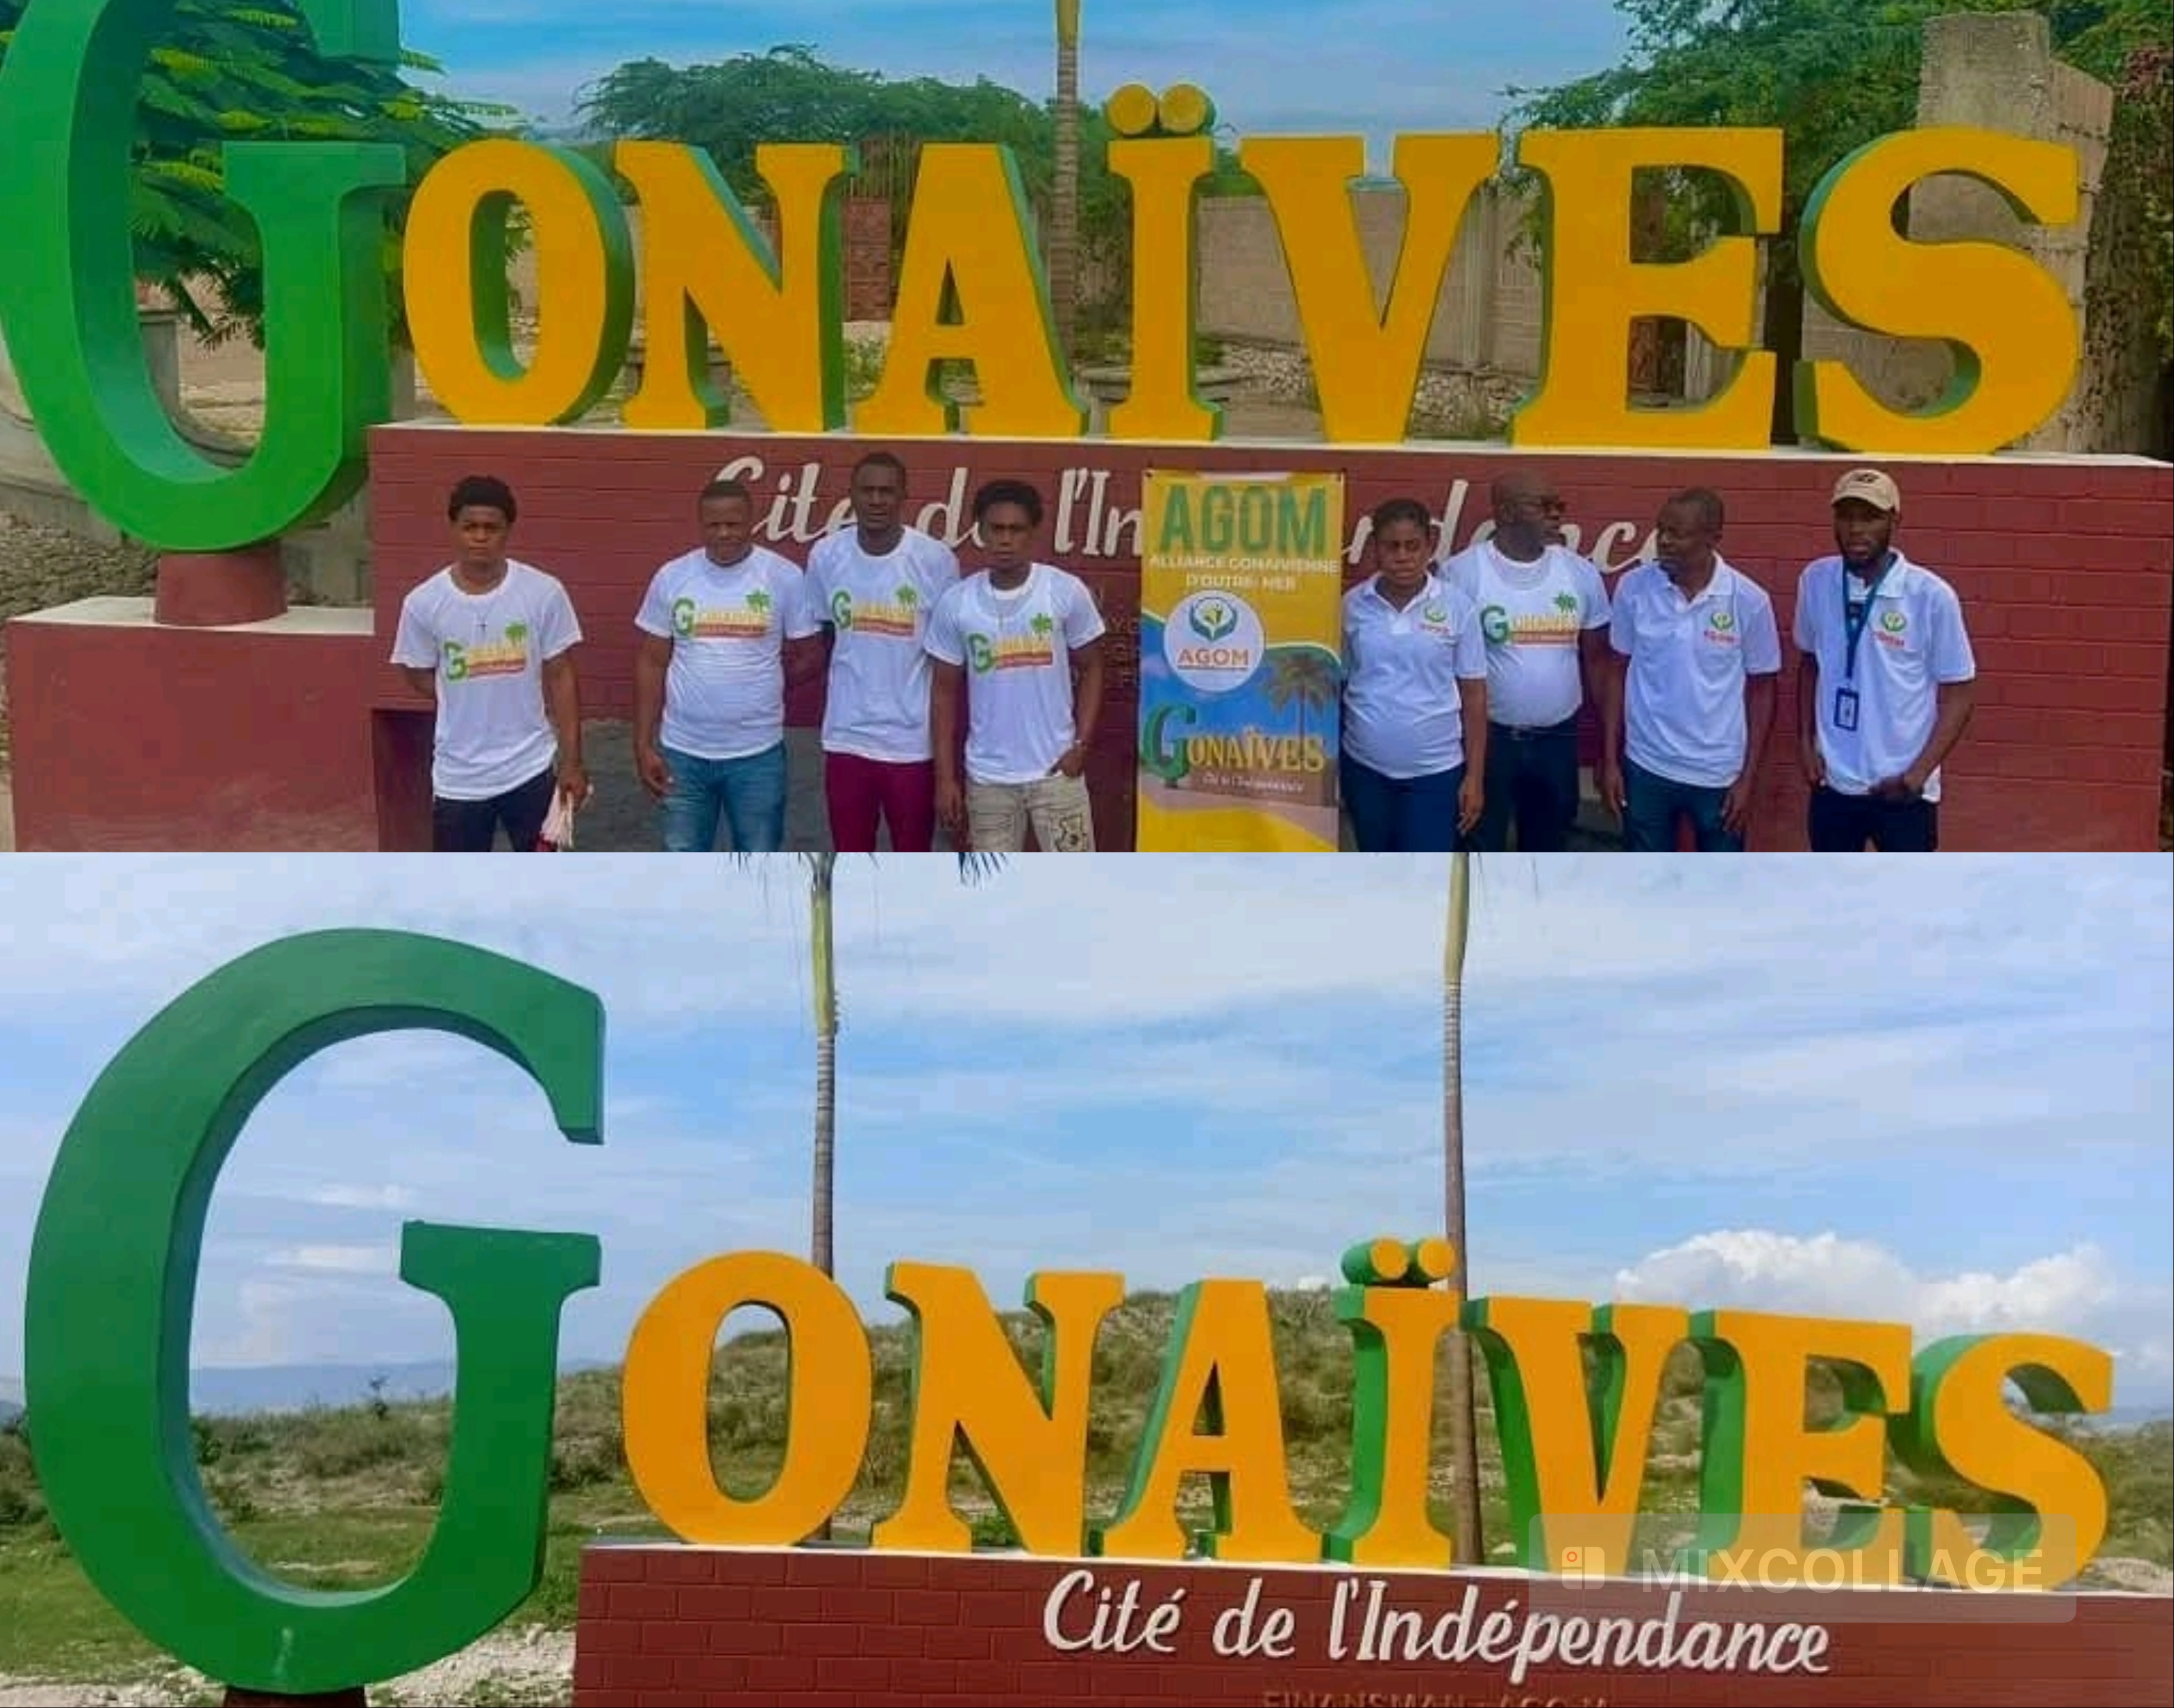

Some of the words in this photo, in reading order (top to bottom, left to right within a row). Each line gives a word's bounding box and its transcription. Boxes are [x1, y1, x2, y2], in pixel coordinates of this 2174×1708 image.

[1159, 483, 1327, 555] AGOM
[1176, 648, 1248, 665] AGOM
[24, 928, 2114, 1694] GONAÏVES
[1043, 1569, 1186, 1653] Cité
[1212, 1577, 1295, 1658] de
[1329, 1577, 1830, 1685] l'Indépendance
